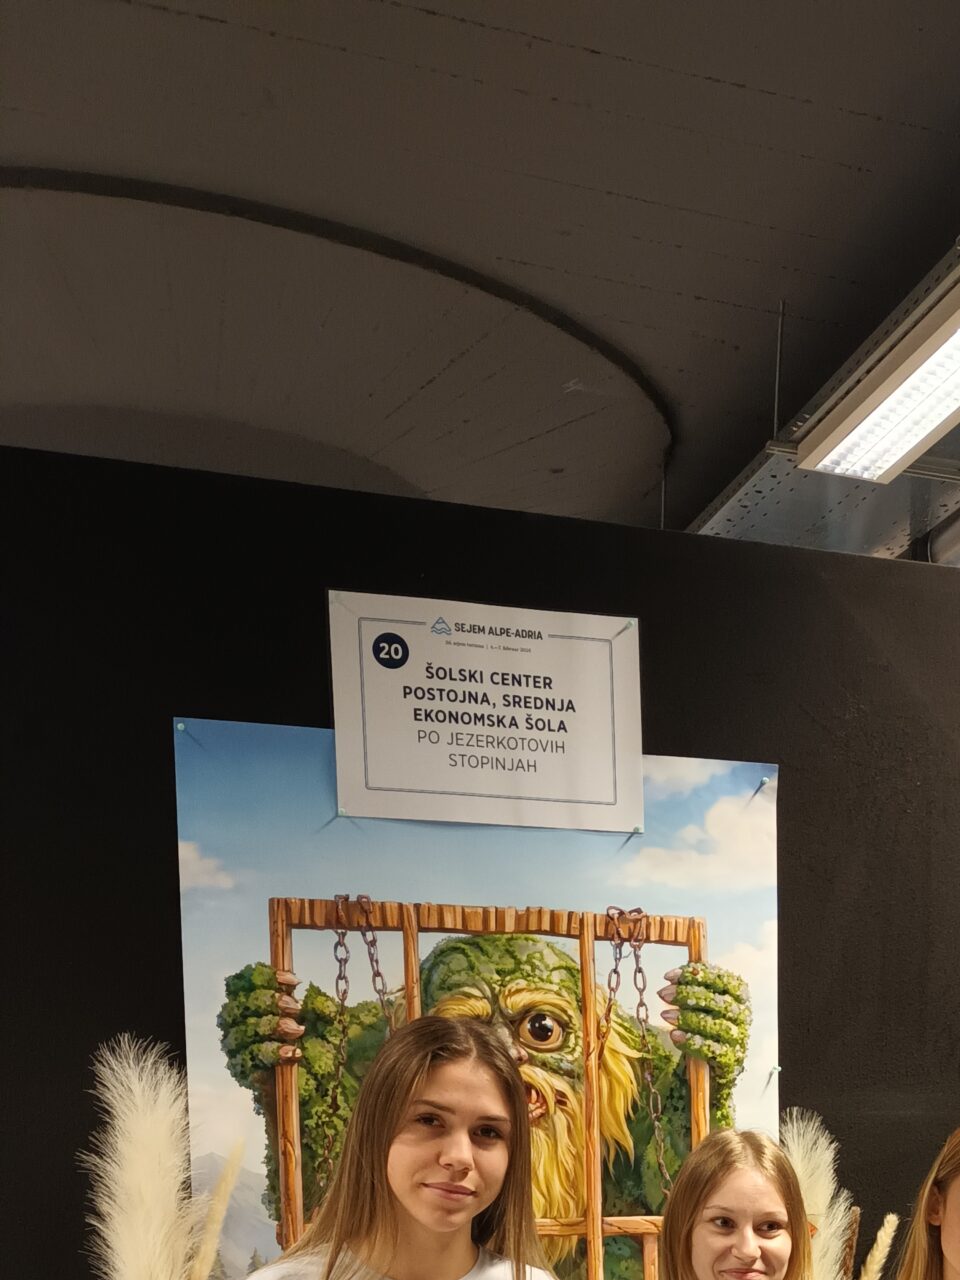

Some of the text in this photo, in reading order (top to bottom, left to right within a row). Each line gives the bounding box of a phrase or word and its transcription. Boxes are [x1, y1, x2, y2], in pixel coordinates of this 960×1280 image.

[454, 622, 543, 640] SEJEM ALPE-ADRIA
[379, 642, 403, 660] 20
[425, 661, 553, 690] ŠOLSKI CENTER
[402, 685, 576, 713] POSTOJNA, SREDNJA
[413, 707, 568, 734] EKONOMSKA ŠOLA
[417, 729, 566, 755] PO JEZERKOTOVIH
[448, 752, 538, 773] STOPINJAH
